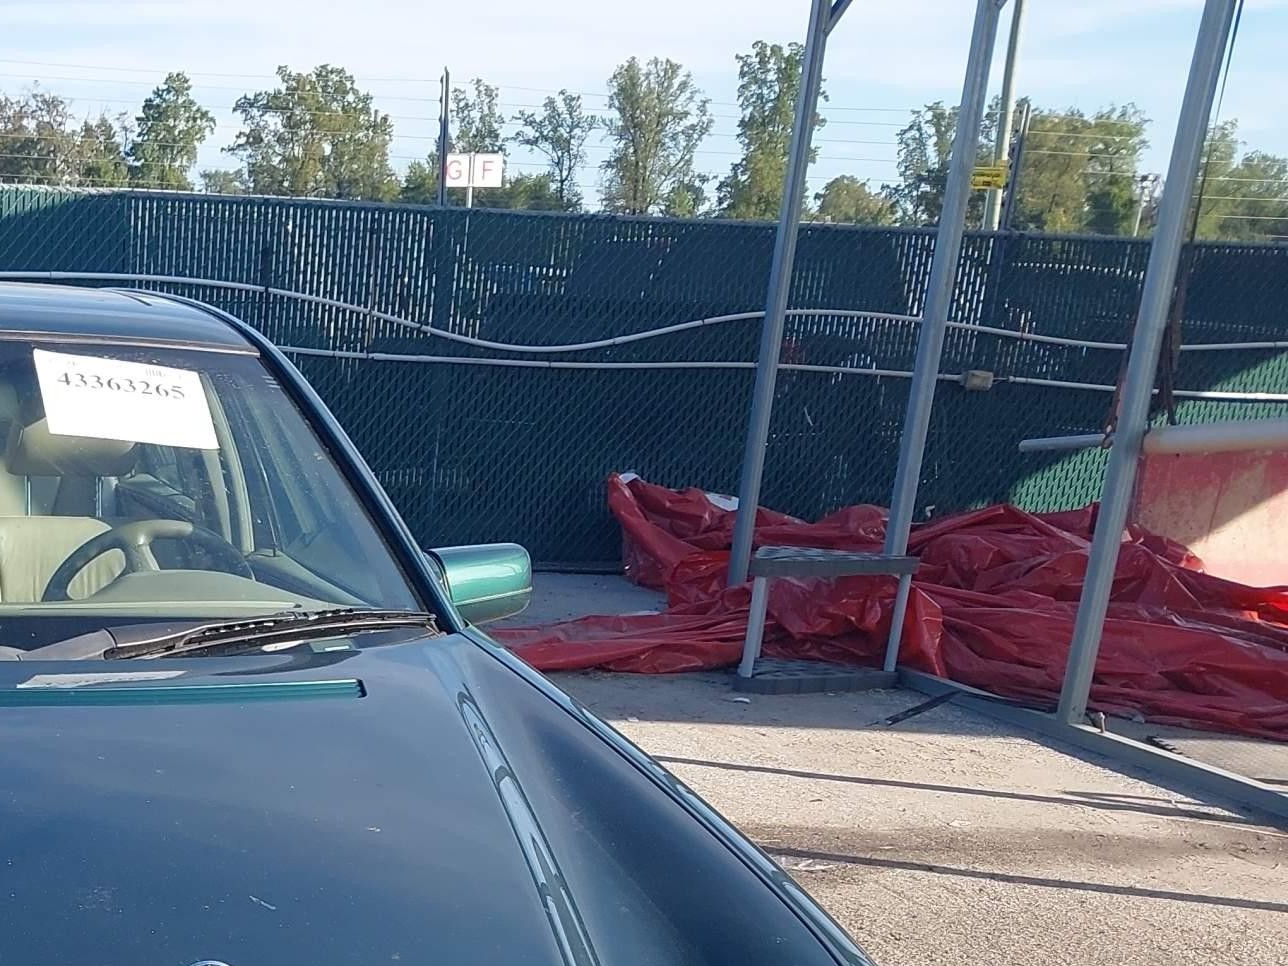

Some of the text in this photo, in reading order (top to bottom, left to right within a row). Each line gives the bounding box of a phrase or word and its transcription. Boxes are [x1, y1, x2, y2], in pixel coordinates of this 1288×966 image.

[446, 159, 495, 181] G F
[57, 371, 185, 400] 43363265
